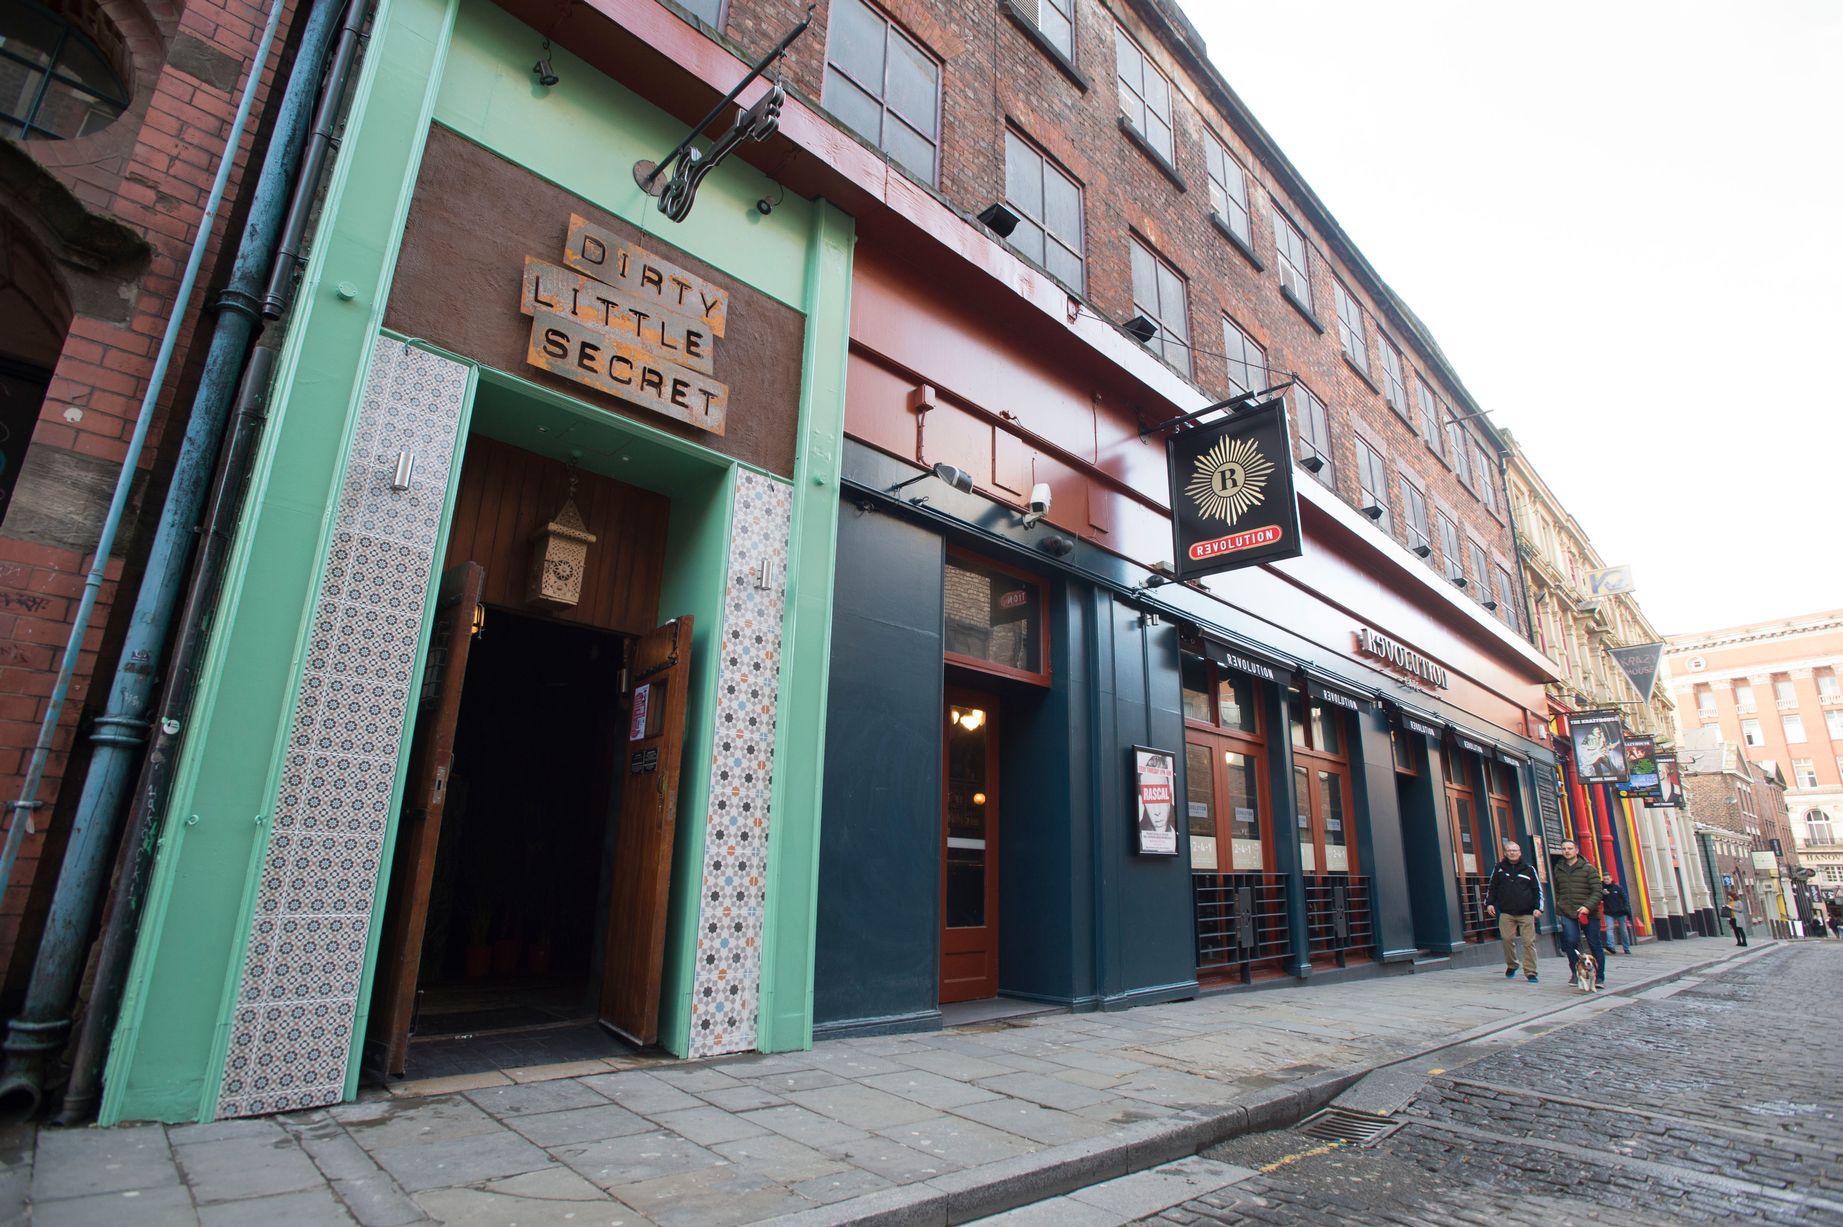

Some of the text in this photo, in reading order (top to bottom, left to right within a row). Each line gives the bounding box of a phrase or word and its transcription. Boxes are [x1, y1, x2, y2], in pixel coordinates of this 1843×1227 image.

[581, 234, 719, 318] DIRTY
[534, 275, 705, 360] LITTLE
[542, 327, 719, 416] SECRET
[1217, 467, 1240, 492] R
[1196, 529, 1274, 556] REVOLUTION
[1226, 653, 1274, 679] REVOLUTION
[1143, 787, 1170, 801] RASCAL
